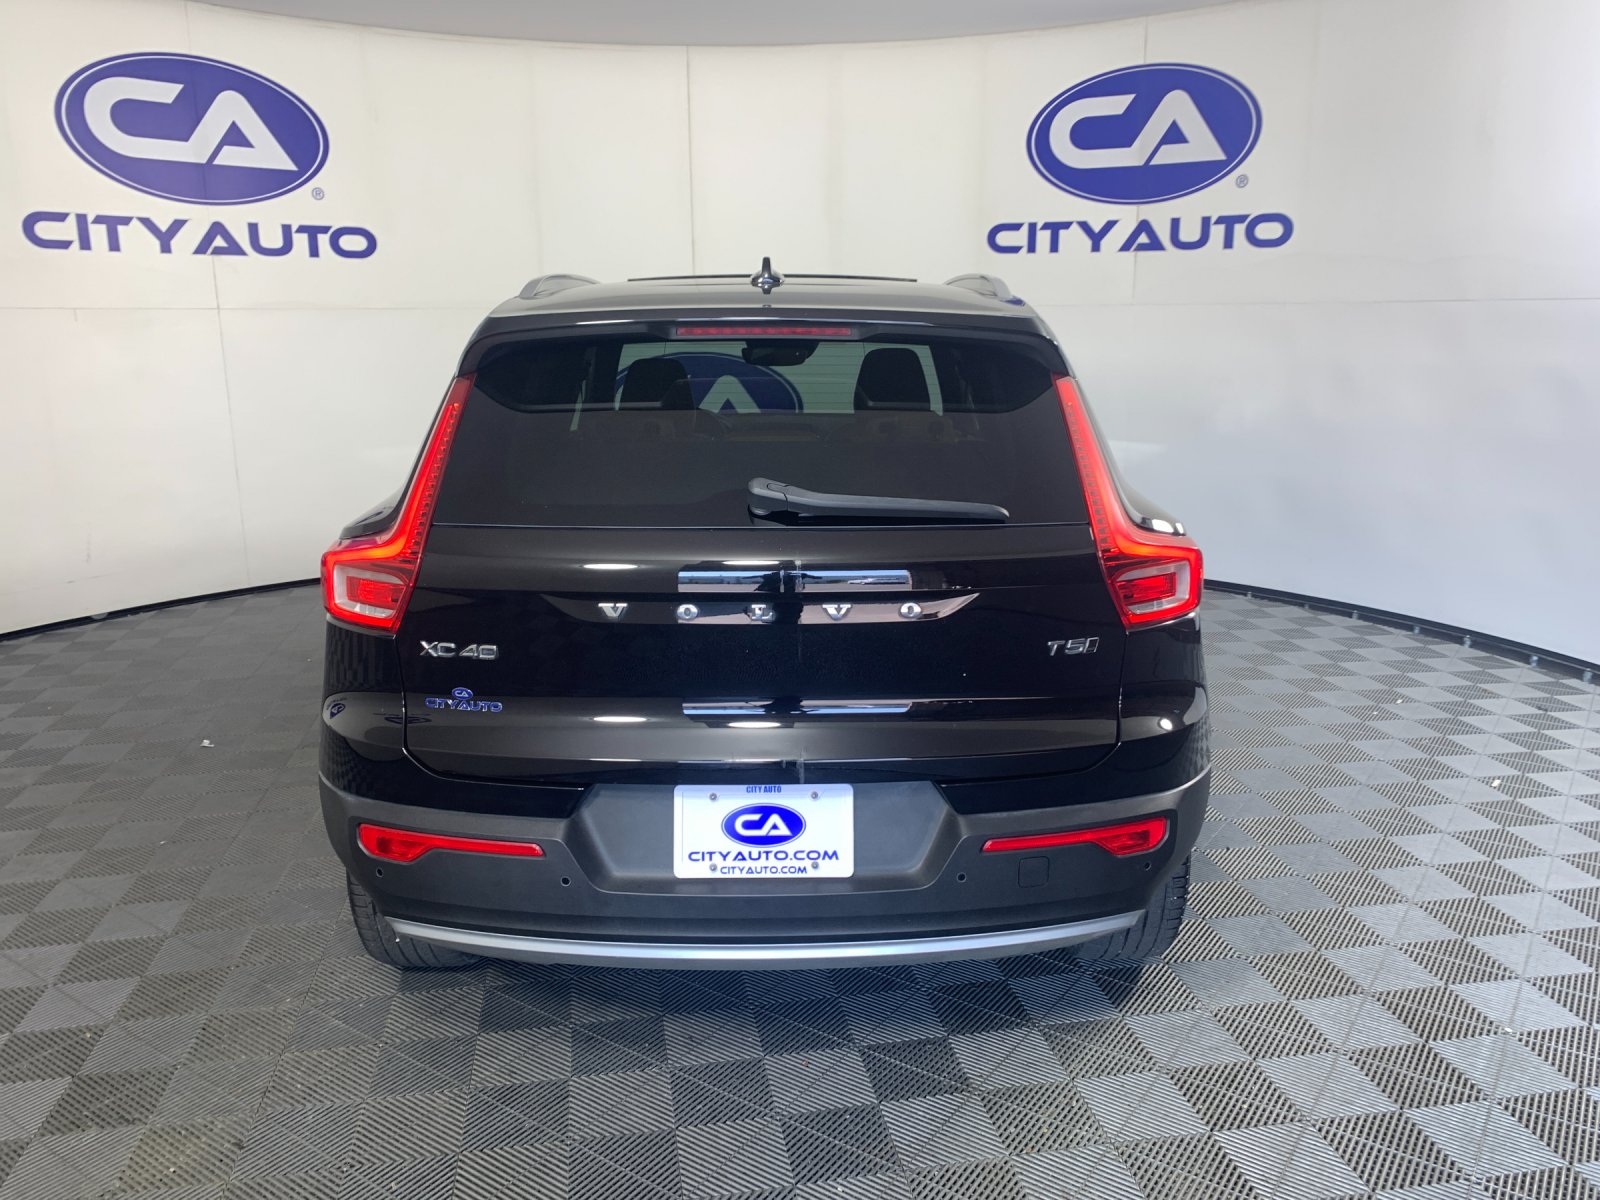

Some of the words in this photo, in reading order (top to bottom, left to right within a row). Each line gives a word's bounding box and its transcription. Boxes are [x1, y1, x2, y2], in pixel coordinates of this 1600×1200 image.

[83, 76, 299, 171] CA
[1049, 89, 1228, 169] CA
[597, 602, 923, 622] VOLVO
[746, 785, 762, 793] CITY
[763, 785, 782, 793] AUTO
[734, 813, 793, 837] CA
[688, 850, 839, 862] CITYAUTO.COM
[720, 865, 807, 875] CITYAUTO.COM
